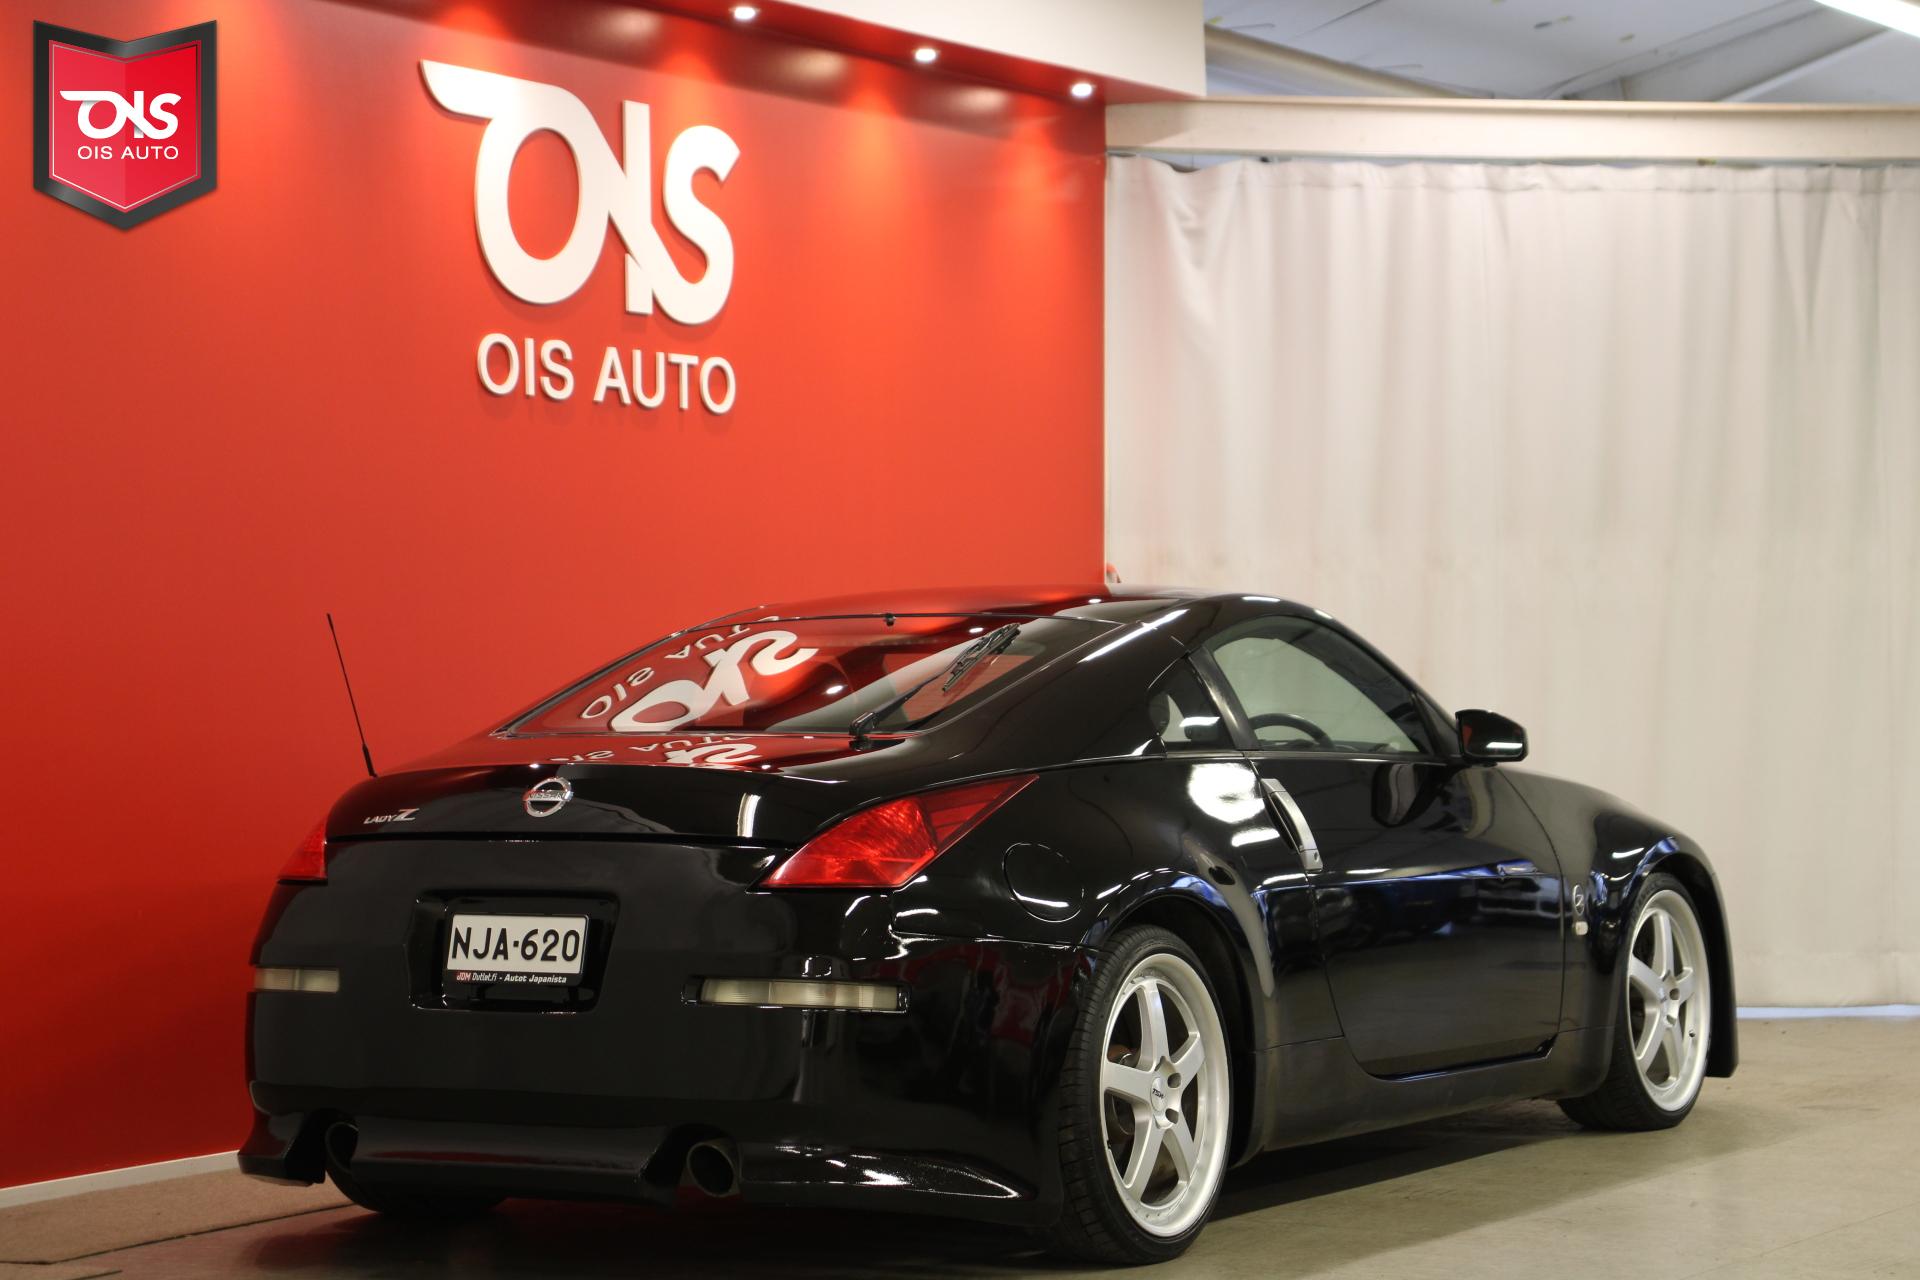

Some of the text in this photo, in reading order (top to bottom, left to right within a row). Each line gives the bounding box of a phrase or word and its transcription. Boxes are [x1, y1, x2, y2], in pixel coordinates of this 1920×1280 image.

[418, 59, 741, 325] OIS
[476, 332, 737, 415] OIS AUTO
[456, 972, 471, 982] JDM
[528, 974, 567, 984] Japanista
